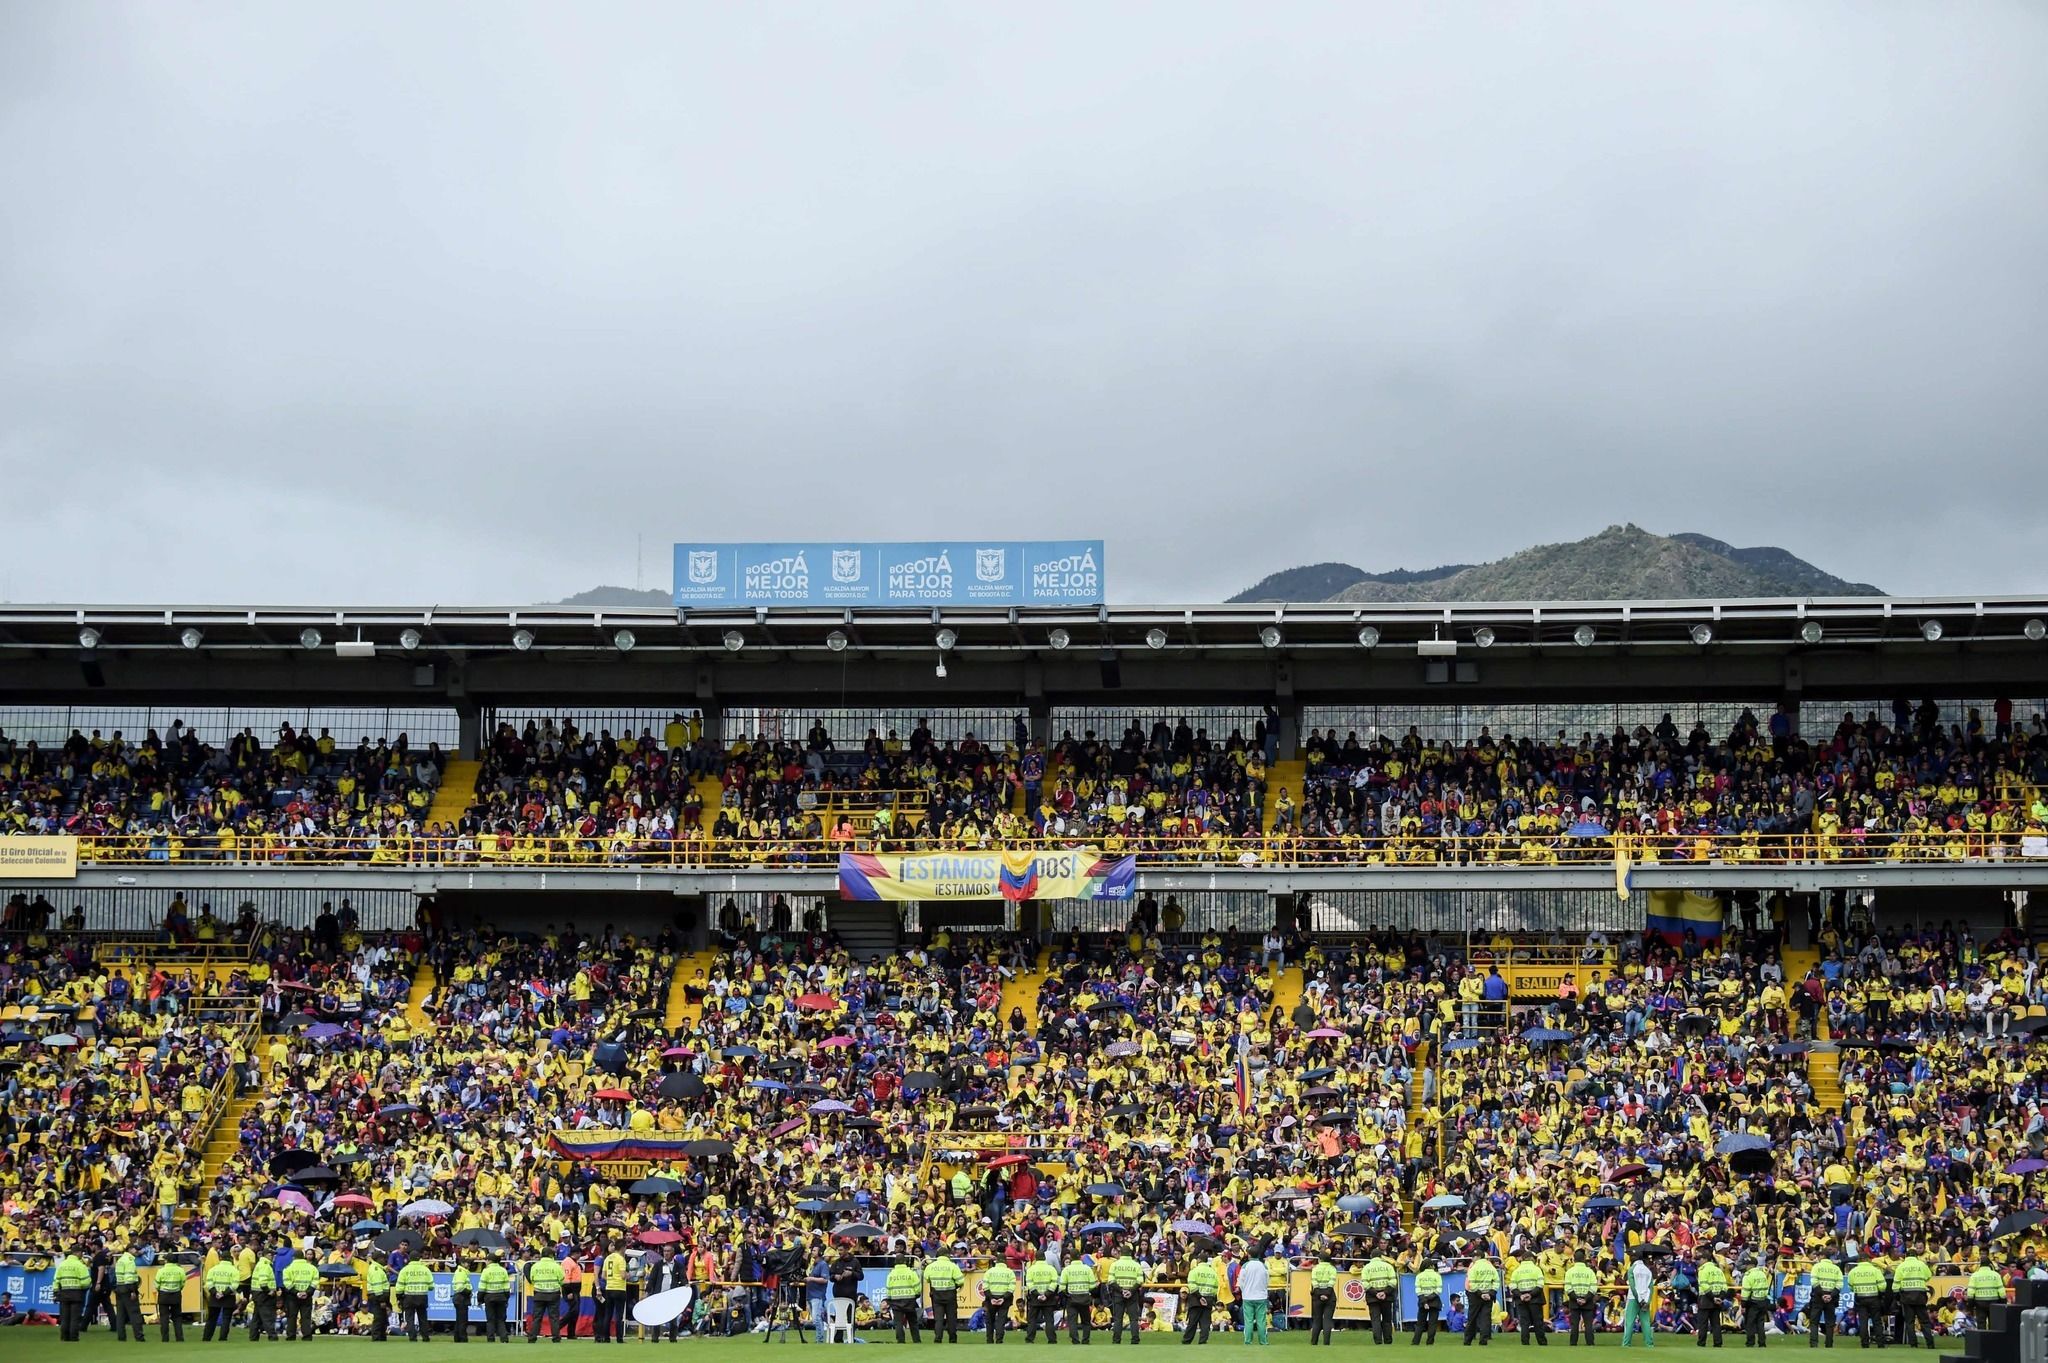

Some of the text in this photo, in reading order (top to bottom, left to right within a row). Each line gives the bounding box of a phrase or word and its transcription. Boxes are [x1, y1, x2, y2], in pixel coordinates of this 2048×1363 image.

[745, 550, 809, 575] BOGOTÁ
[889, 549, 953, 574] BOGOTÁ
[1033, 547, 1097, 573] BOGOTÁ
[745, 575, 809, 590] MEJOR
[889, 574, 953, 589] MEJOR
[1033, 573, 1097, 588] MEJOR
[745, 590, 809, 599] PARA TODOS
[889, 590, 953, 599] PARA TODOS
[1033, 588, 1097, 598] PARA TODOS
[1, 848, 8, 856] El
[9, 848, 26, 856] Giro
[28, 848, 54, 856] Oficial
[1521, 977, 1565, 989] SALID
[1817, 1267, 1840, 1275] POLICIA
